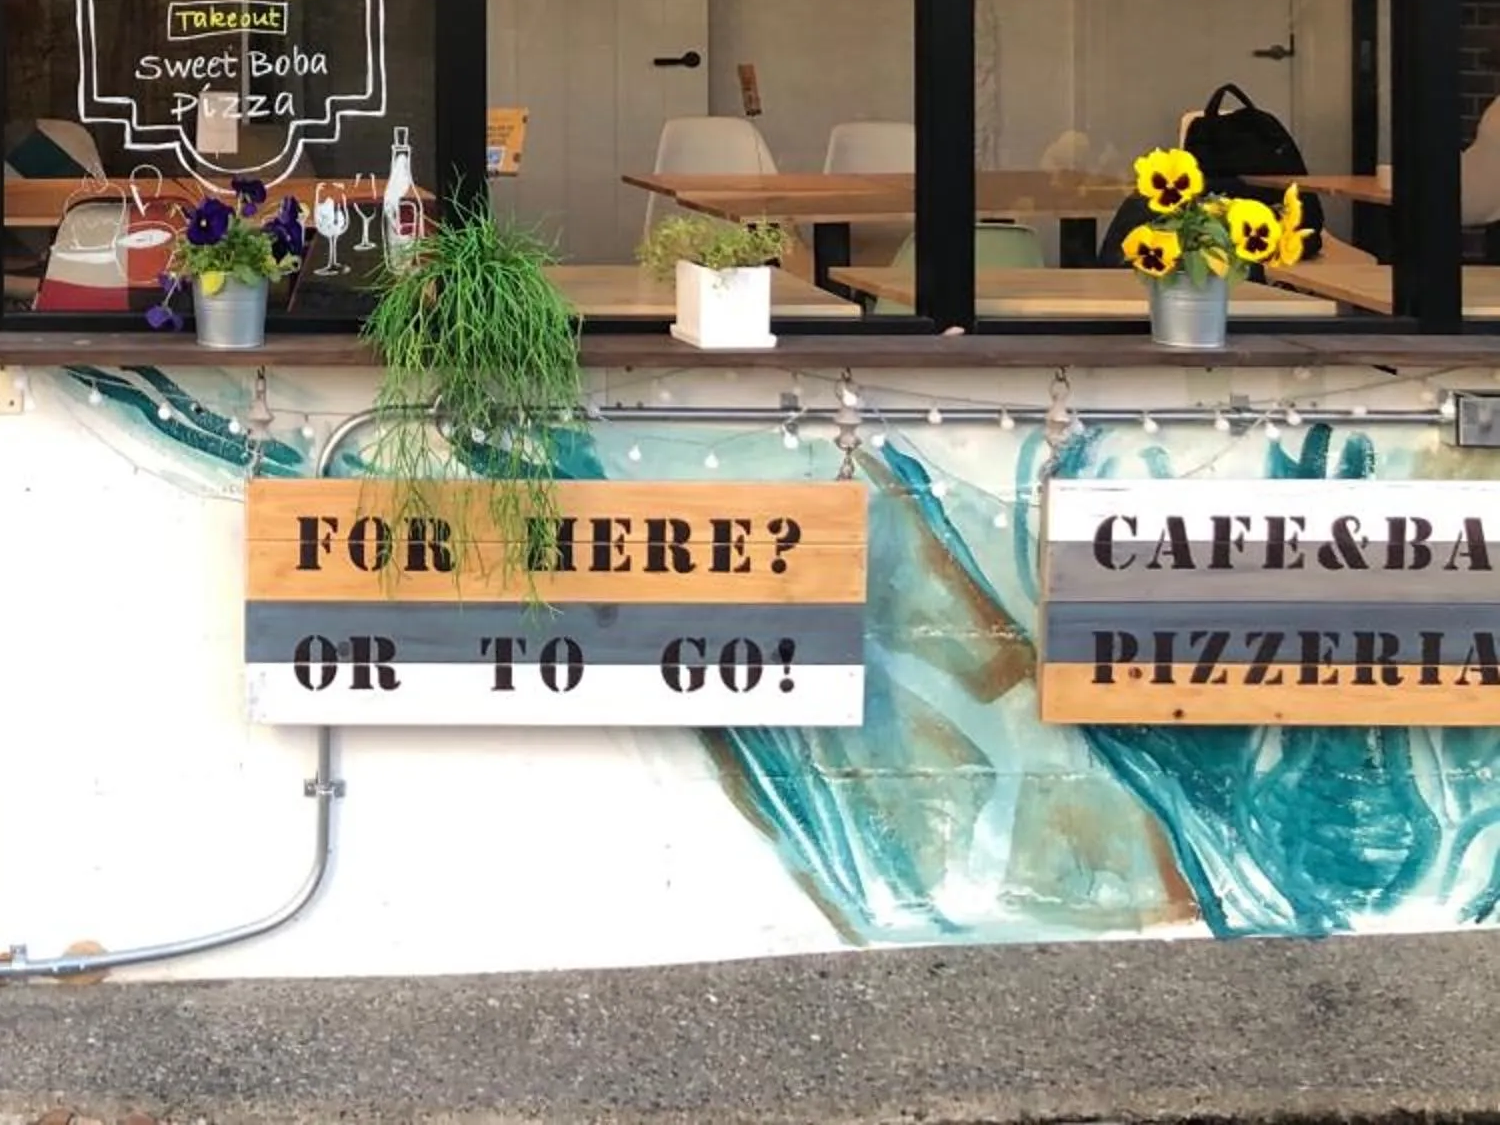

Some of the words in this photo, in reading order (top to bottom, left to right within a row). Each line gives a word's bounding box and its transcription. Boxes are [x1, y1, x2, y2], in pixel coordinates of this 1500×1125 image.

[176, 6, 284, 27] Takeout
[135, 53, 238, 80] Sweet
[248, 45, 328, 76] Boba
[171, 83, 295, 121] Pizza
[295, 516, 455, 573] FOR
[526, 516, 802, 574] HERE?
[293, 634, 401, 692] OR
[480, 636, 585, 694] TO
[661, 636, 797, 695] GO!
[1090, 631, 1500, 686] PIZZERIA
